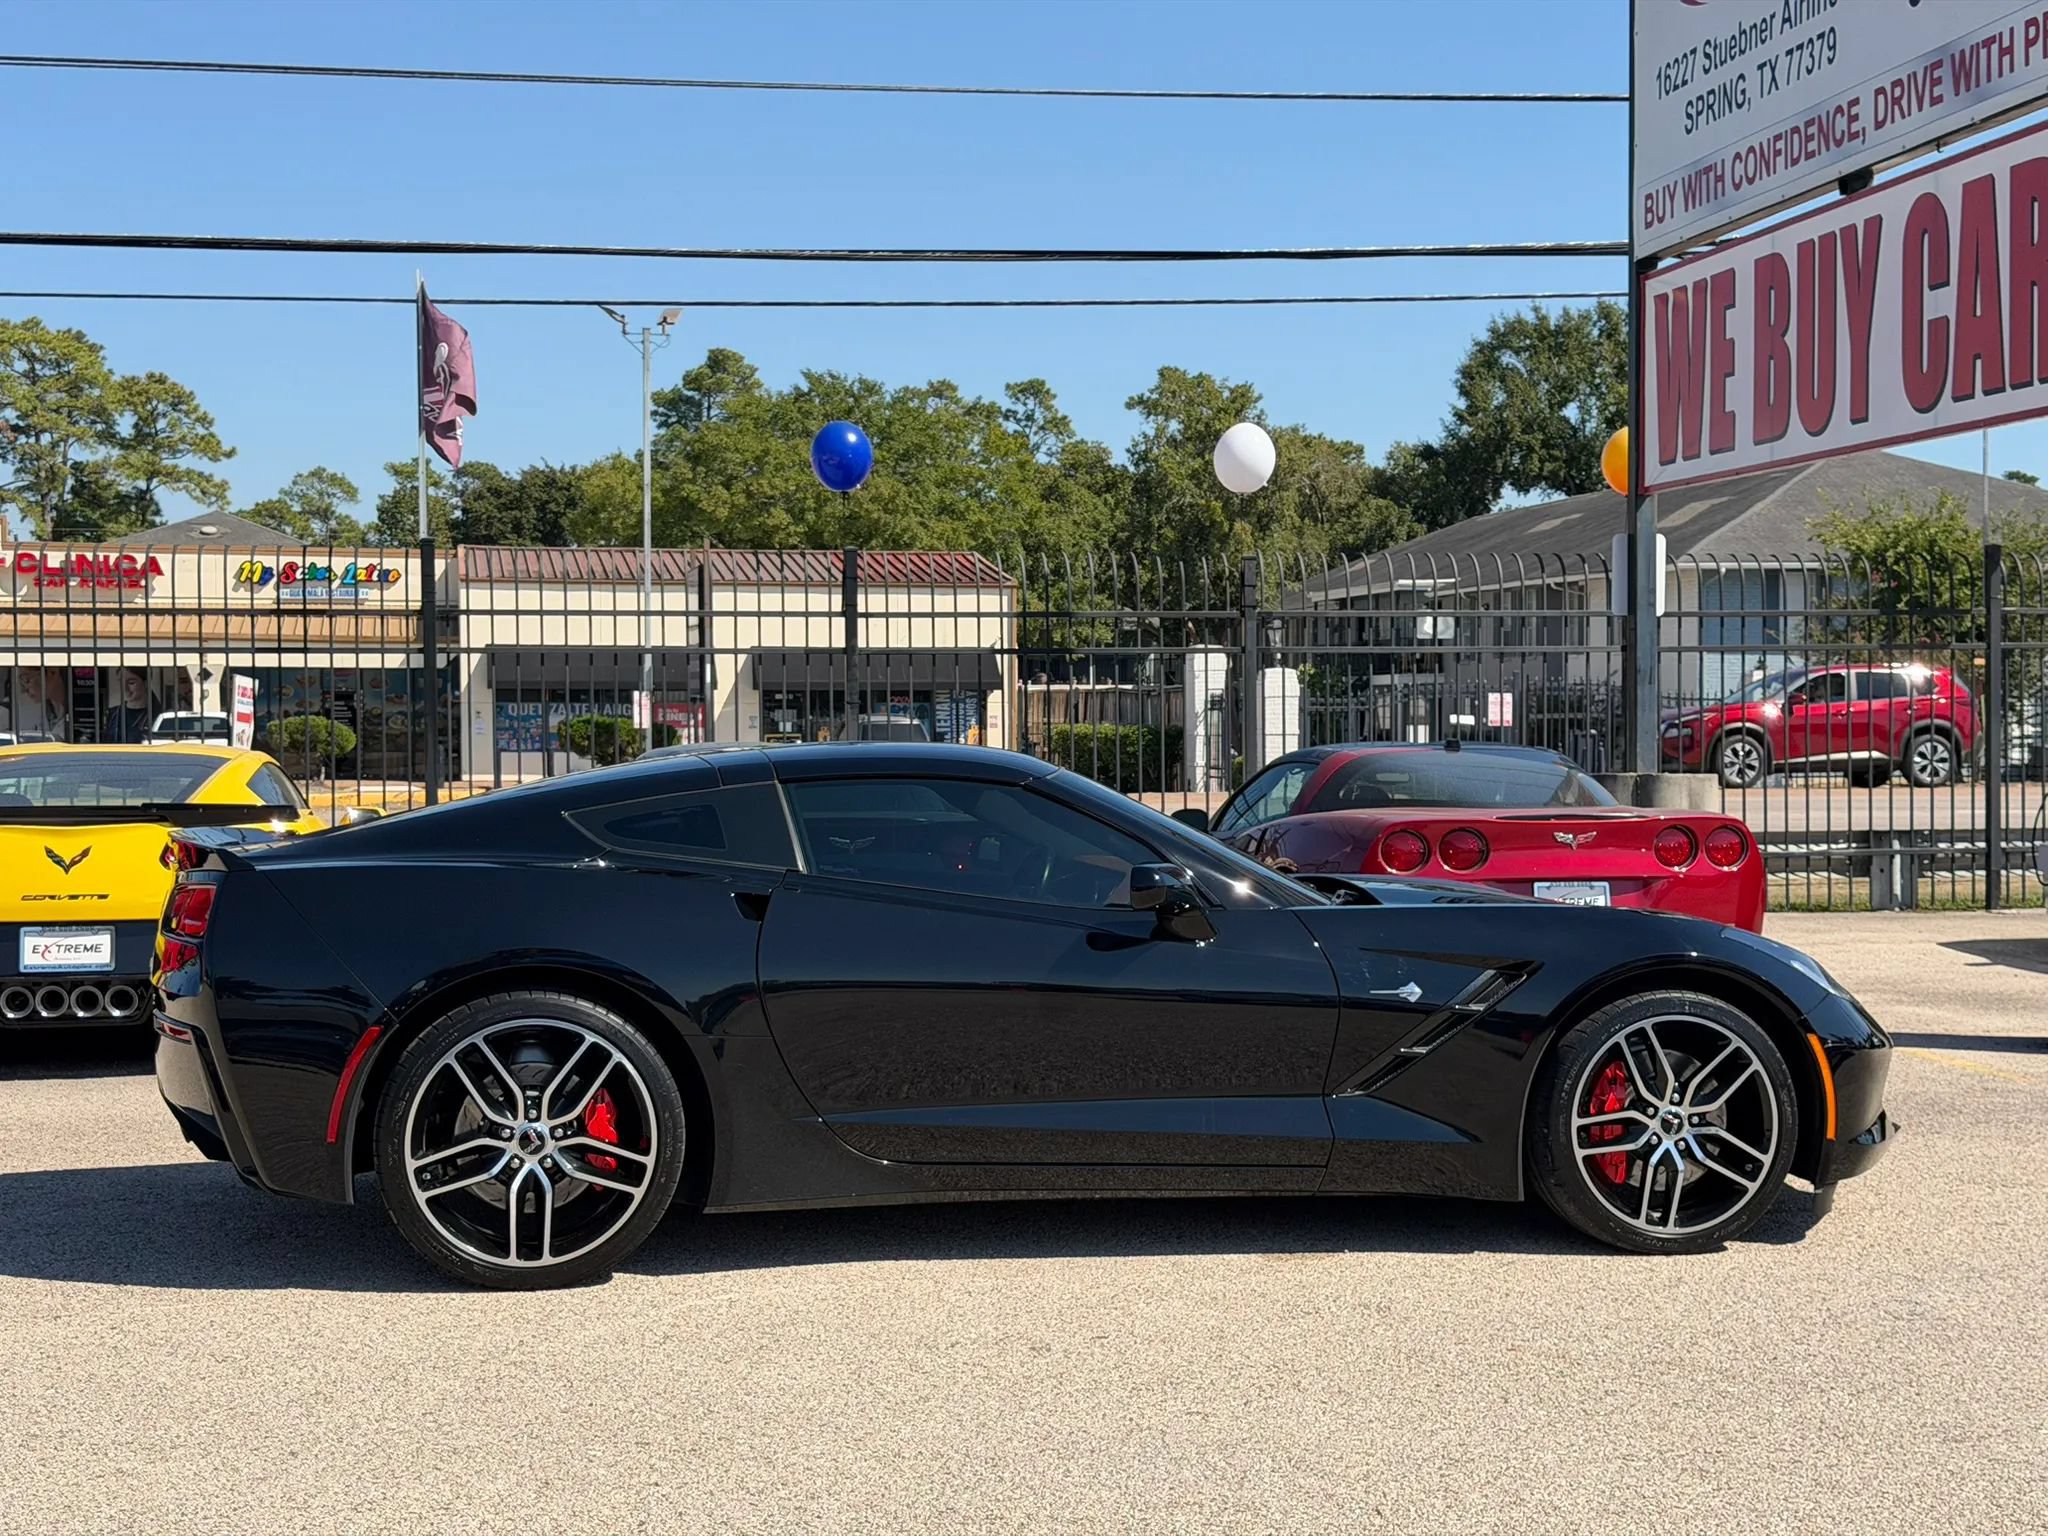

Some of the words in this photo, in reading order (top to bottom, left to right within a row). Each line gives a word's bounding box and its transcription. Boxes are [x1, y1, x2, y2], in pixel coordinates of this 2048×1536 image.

[1656, 46, 1697, 100] 16227
[1702, 11, 1776, 75] Stuebner
[1684, 73, 1751, 135] SPRING,
[1757, 54, 1780, 98] TX
[1785, 26, 1837, 86] 77379
[1644, 183, 1679, 230] BUY
[1682, 157, 1726, 213] WITH
[1731, 97, 1867, 192] CONFIDENCE,
[1874, 58, 1944, 131] DRIVE
[1950, 26, 2015, 97] WITH
[1654, 267, 1736, 467] WE
[1753, 213, 1882, 446] BUY
[32, 943, 103, 956] EXTREME
